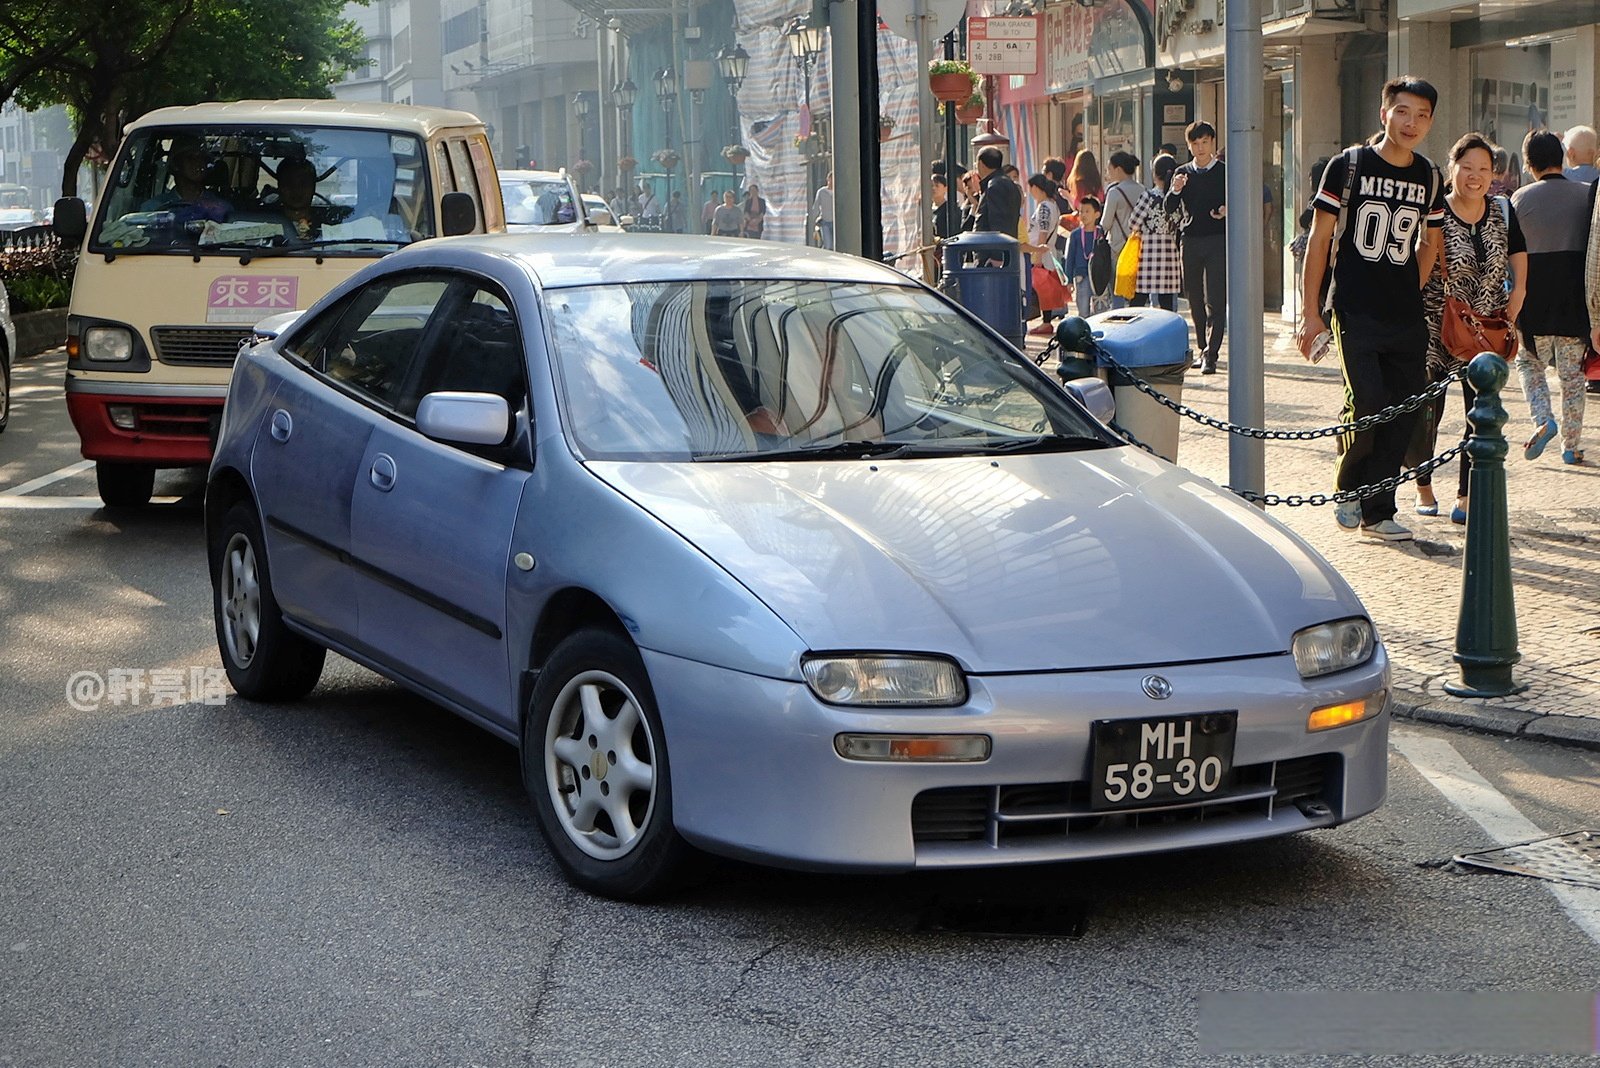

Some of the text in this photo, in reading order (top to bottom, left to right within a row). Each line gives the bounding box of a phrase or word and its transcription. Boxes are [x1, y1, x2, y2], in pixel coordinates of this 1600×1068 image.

[989, 20, 1007, 28] PRAIA
[1359, 175, 1426, 205] MISTER
[1353, 200, 1420, 266] 09
[1140, 721, 1192, 761] MH
[1104, 756, 1222, 802] 58-30
